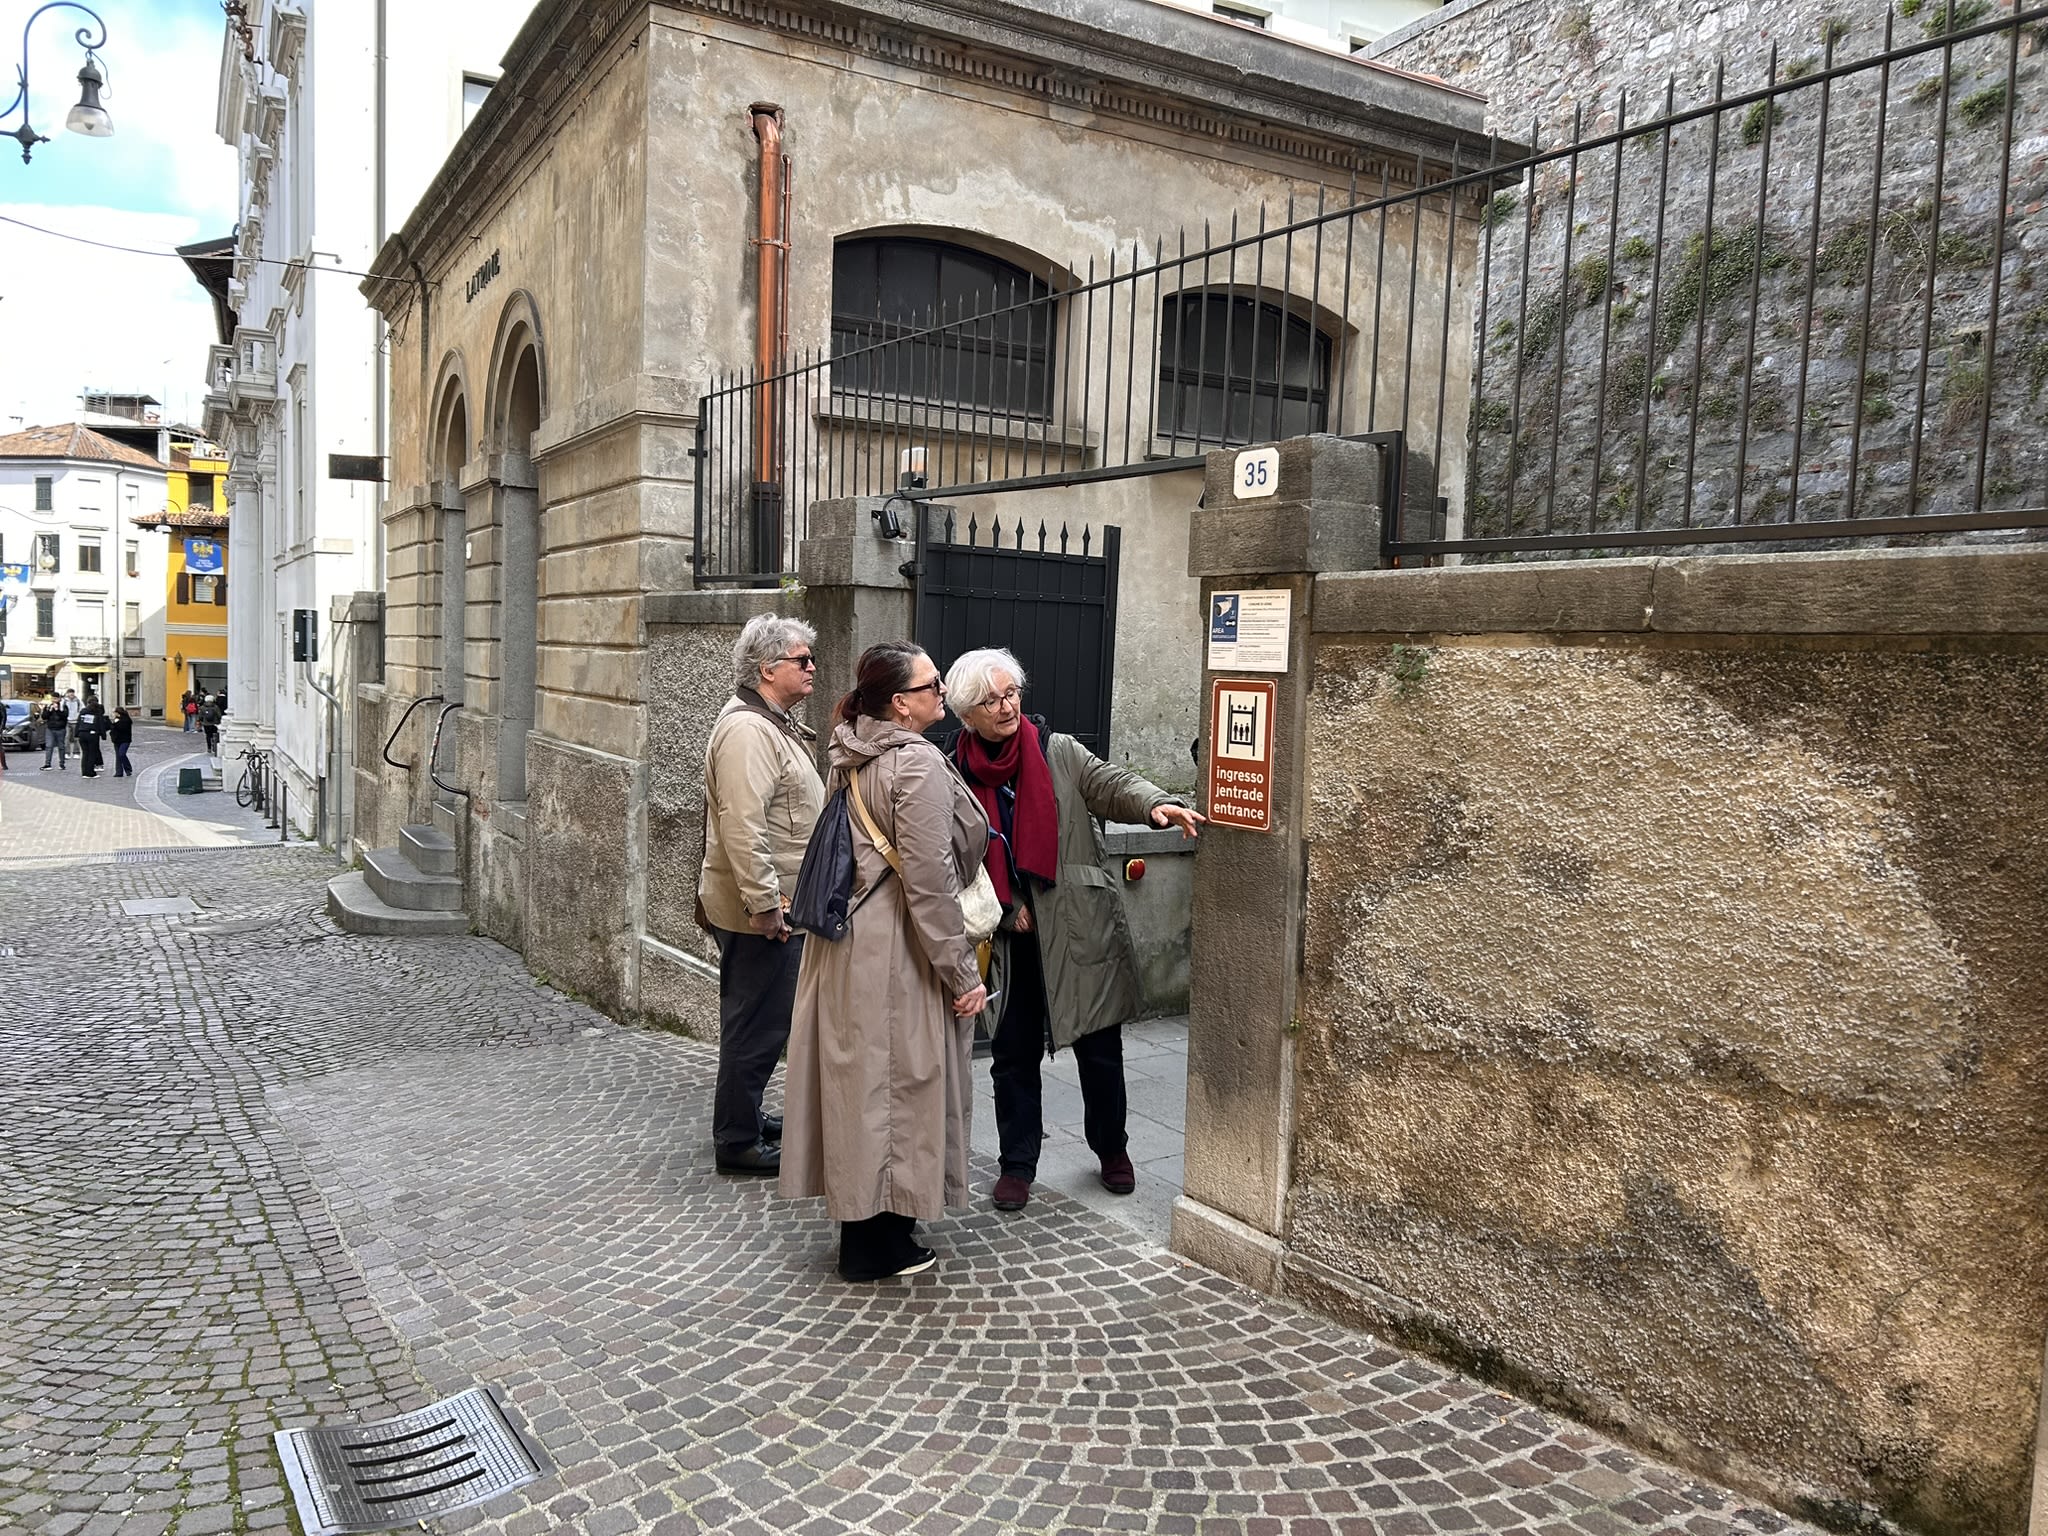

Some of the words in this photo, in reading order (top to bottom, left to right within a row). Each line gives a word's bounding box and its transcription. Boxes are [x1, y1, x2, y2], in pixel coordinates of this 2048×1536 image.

[466, 247, 501, 304] LATRINE
[1245, 460, 1267, 487] 35
[1216, 765, 1264, 784] ingresso
[1215, 783, 1264, 802] jentrade
[1213, 802, 1265, 820] entrance
